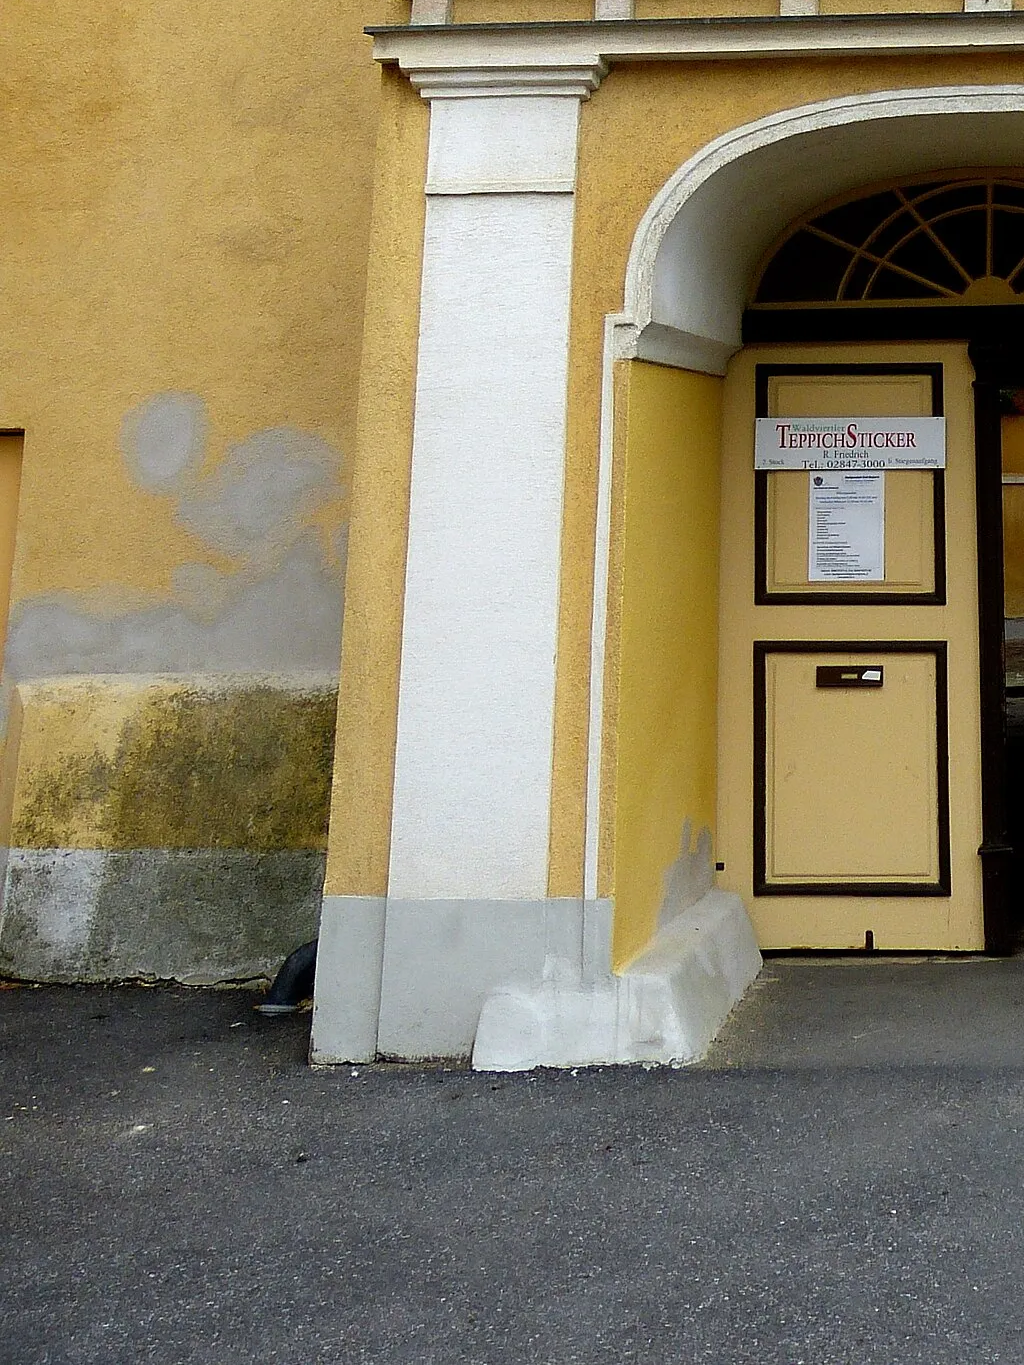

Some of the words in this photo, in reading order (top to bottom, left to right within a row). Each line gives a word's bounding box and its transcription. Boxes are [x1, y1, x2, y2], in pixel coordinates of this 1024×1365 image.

[792, 424, 846, 432] Waldviertler
[823, 450, 832, 459] R.
[834, 449, 869, 459] Friedrich
[801, 460, 824, 468] Tel.:
[826, 459, 885, 468] 02847-3000
